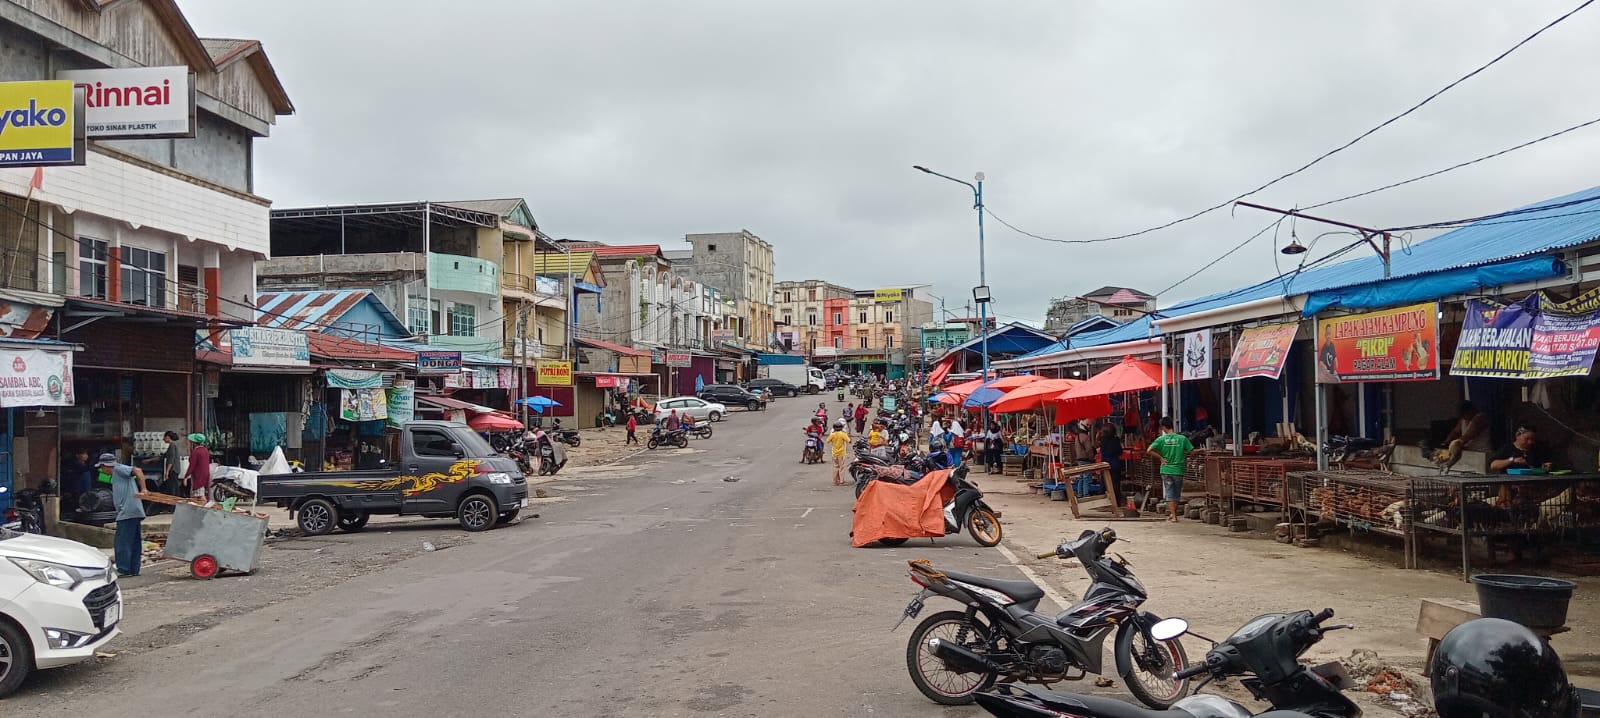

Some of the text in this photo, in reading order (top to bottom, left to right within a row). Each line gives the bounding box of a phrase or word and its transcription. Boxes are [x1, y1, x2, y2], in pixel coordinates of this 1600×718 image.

[128, 123, 157, 131] PLASTIK
[20, 151, 43, 160] JAYA
[1334, 309, 1427, 339] LAPAK AYAM KAMPUNG
[1480, 327, 1533, 348] BERJUALAN
[422, 360, 460, 368] DONGA
[1376, 358, 1397, 370] ALAM
[1472, 349, 1495, 370] LAHAN
[1495, 350, 1531, 371] PARKIR
[0, 376, 28, 389] SAMBAL
